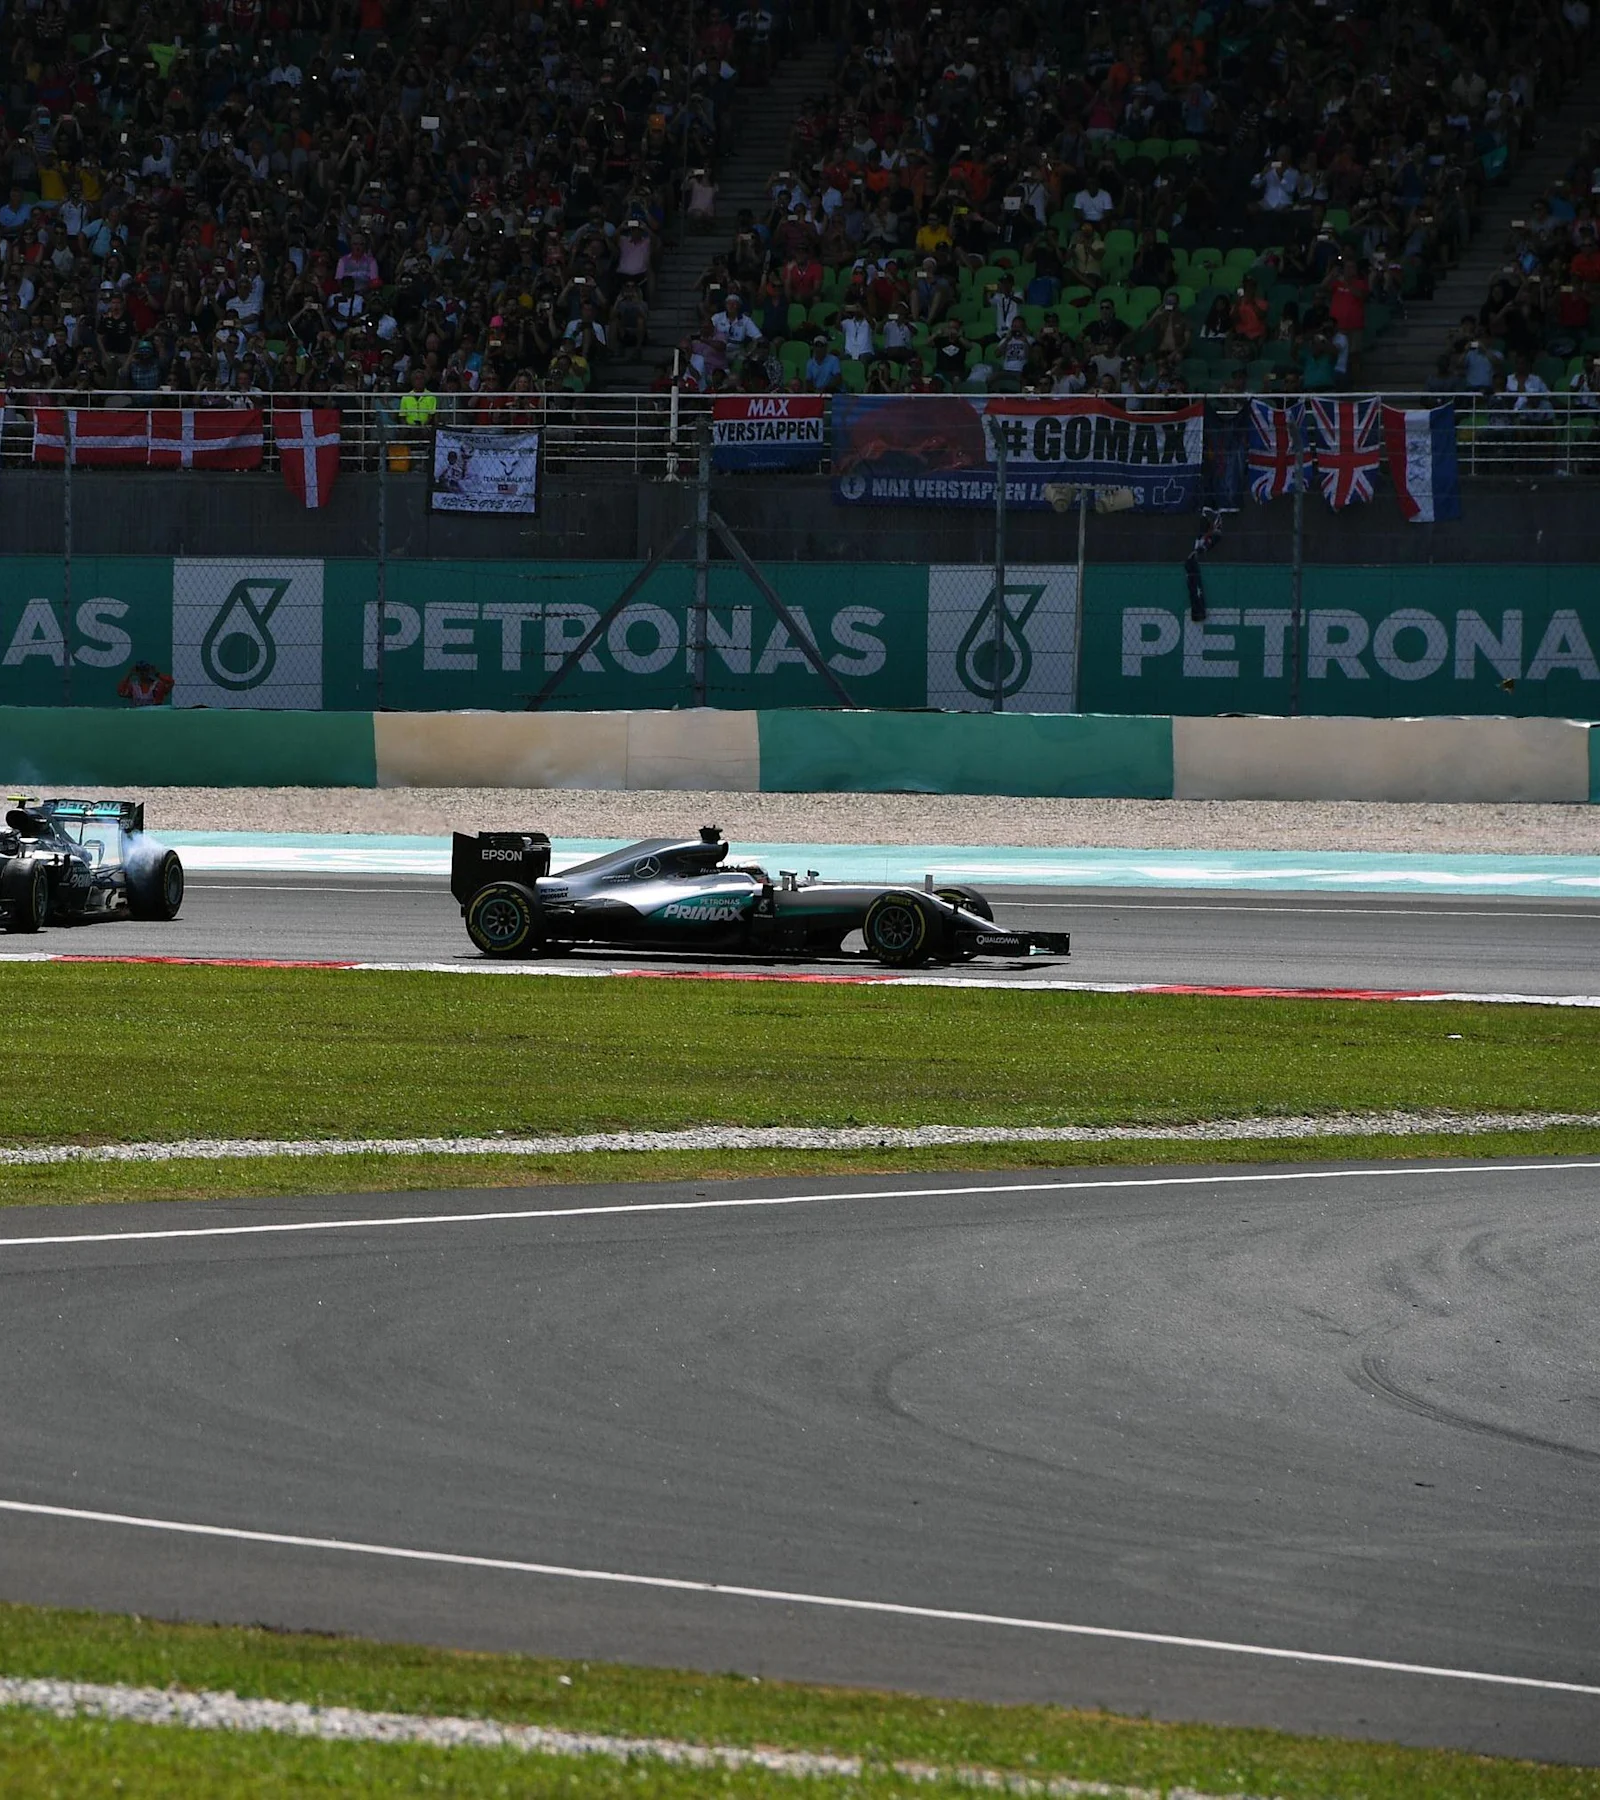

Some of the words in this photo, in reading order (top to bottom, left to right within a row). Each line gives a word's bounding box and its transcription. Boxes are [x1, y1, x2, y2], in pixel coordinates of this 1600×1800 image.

[747, 399, 790, 417] MAX
[717, 420, 819, 441] VERSTAPPEN
[1003, 416, 1187, 464] #GOMAX
[871, 477, 911, 498] MAX
[363, 601, 887, 676] PETRONAS
[481, 849, 523, 861] EPSON
[700, 898, 741, 906] PETRONAS
[663, 903, 745, 922] PRIMAX
